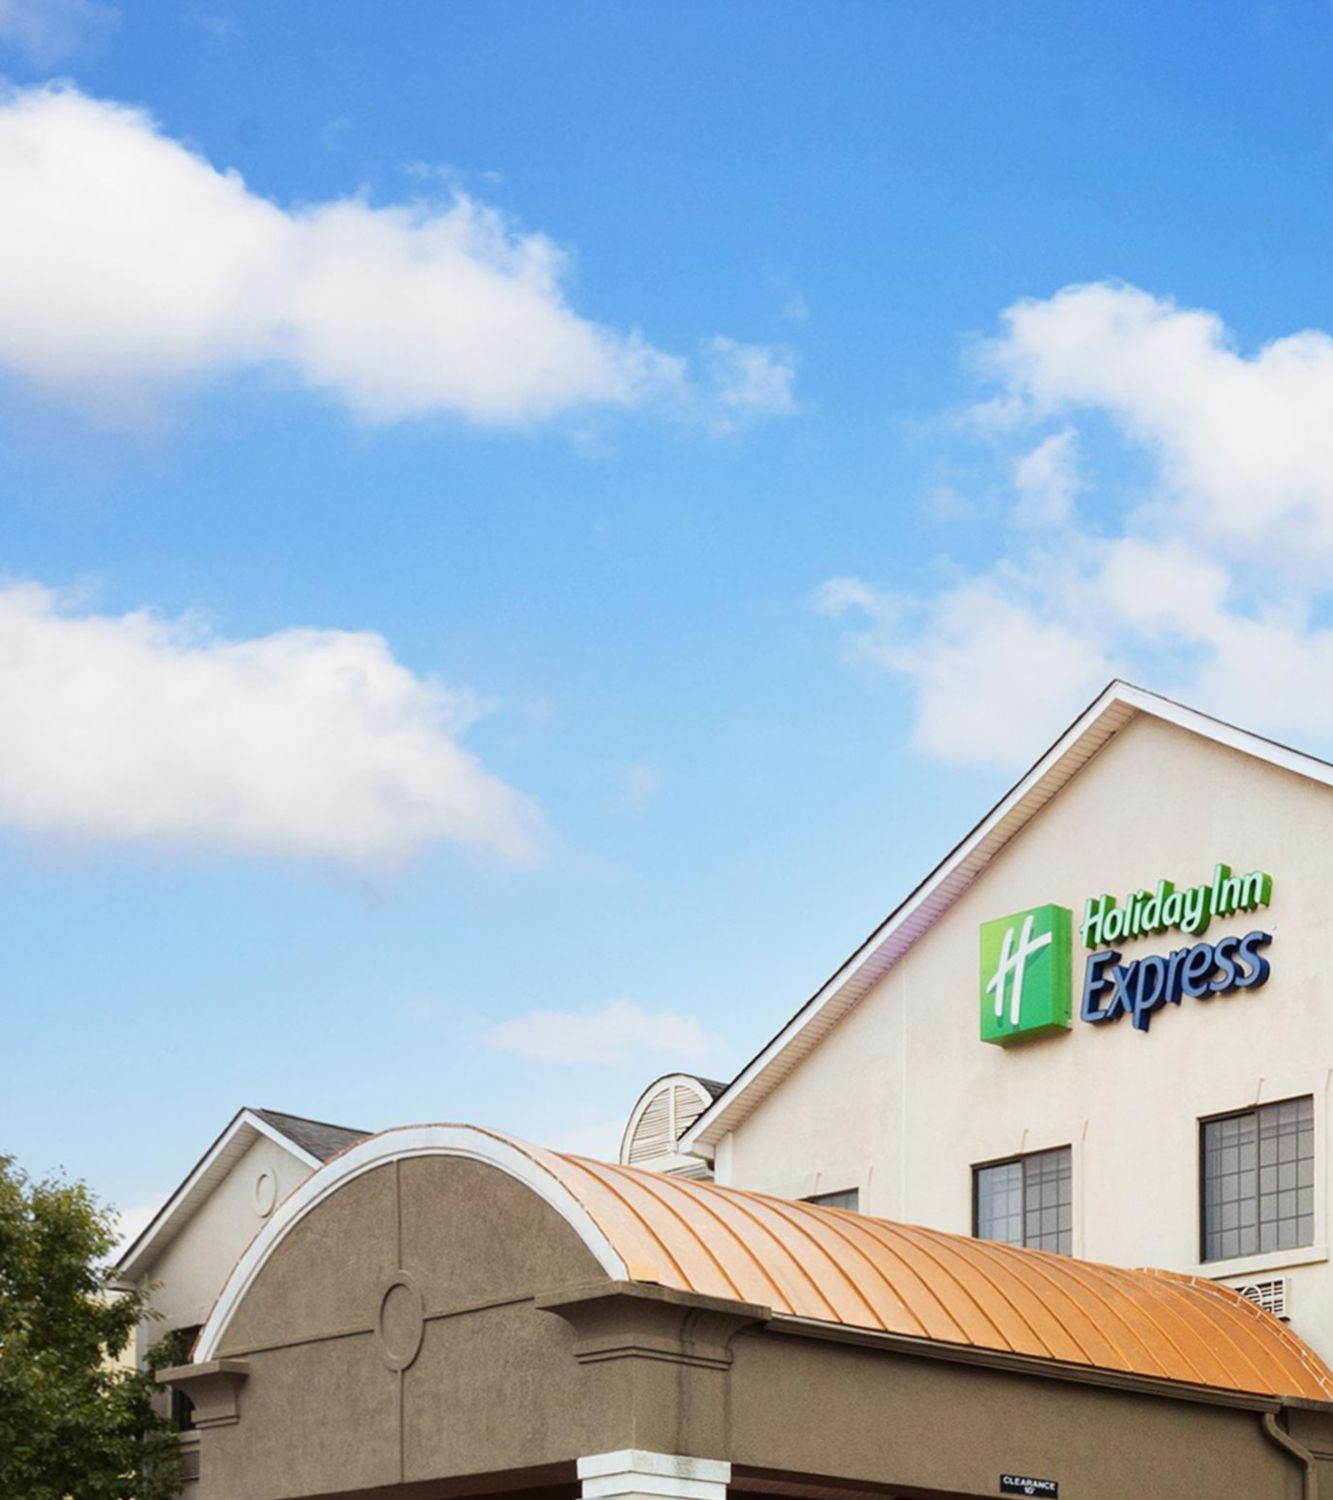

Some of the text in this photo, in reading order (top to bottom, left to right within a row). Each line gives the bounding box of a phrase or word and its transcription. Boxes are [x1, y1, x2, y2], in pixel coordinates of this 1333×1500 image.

[1080, 863, 1273, 949] Holiday Inn
[1080, 931, 1273, 1032] Express
[1003, 1476, 1055, 1491] CLEARANCE
